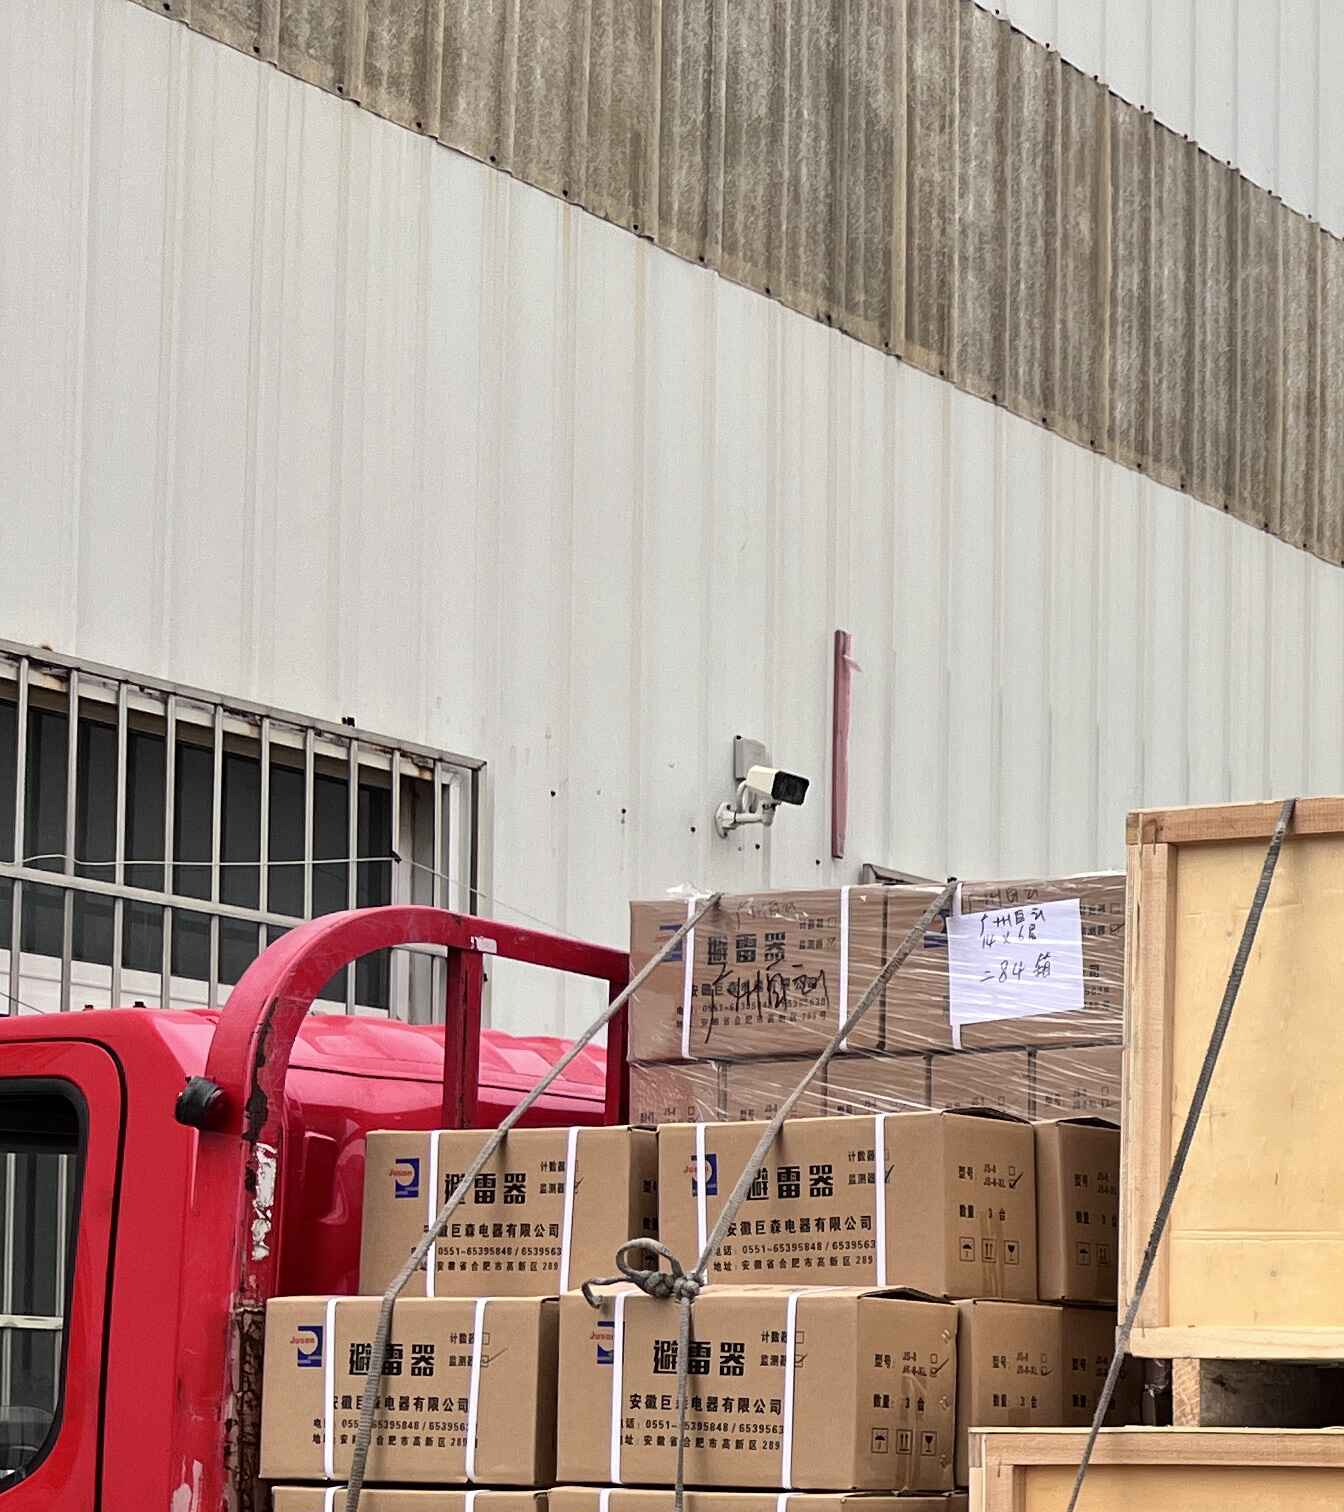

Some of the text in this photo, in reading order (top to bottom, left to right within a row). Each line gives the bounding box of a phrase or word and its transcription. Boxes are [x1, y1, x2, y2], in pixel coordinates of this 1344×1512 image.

[424, 1223, 560, 1239] 徽巨森电器有限公司
[349, 1343, 435, 1377] 避雷器
[653, 1340, 745, 1376] 避雷器
